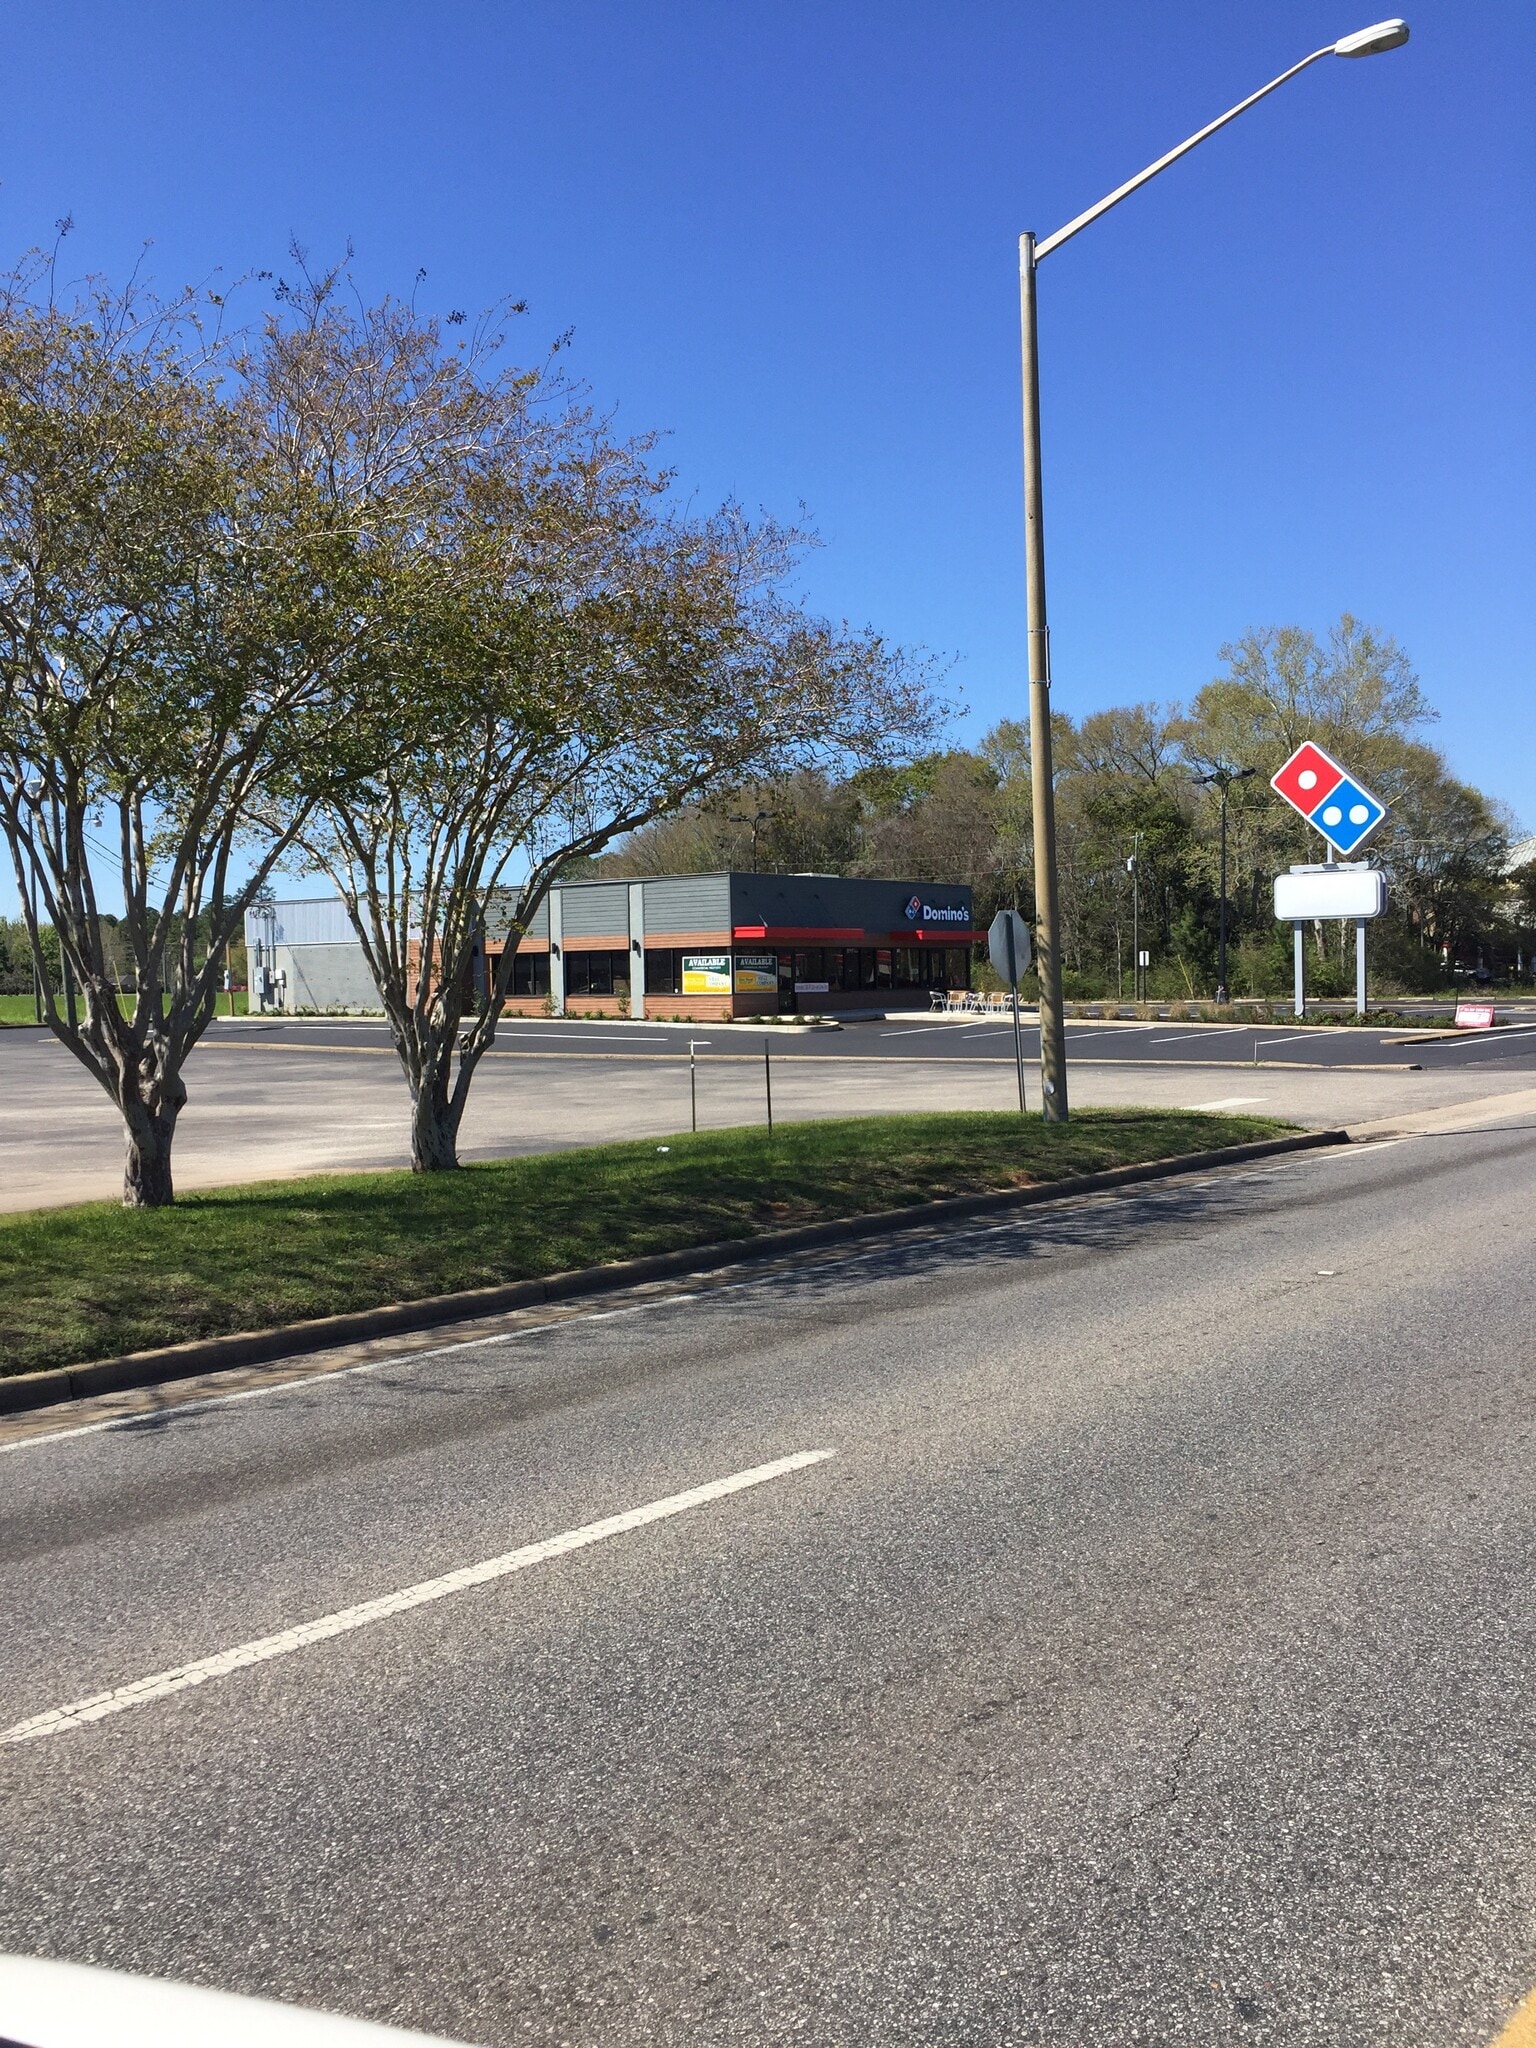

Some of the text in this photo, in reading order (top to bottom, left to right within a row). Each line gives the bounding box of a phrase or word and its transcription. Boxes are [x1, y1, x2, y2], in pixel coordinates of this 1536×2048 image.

[923, 905, 969, 921] Domino's
[688, 958, 726, 966] AVAILABLE
[740, 958, 773, 966] AVAILABLE
